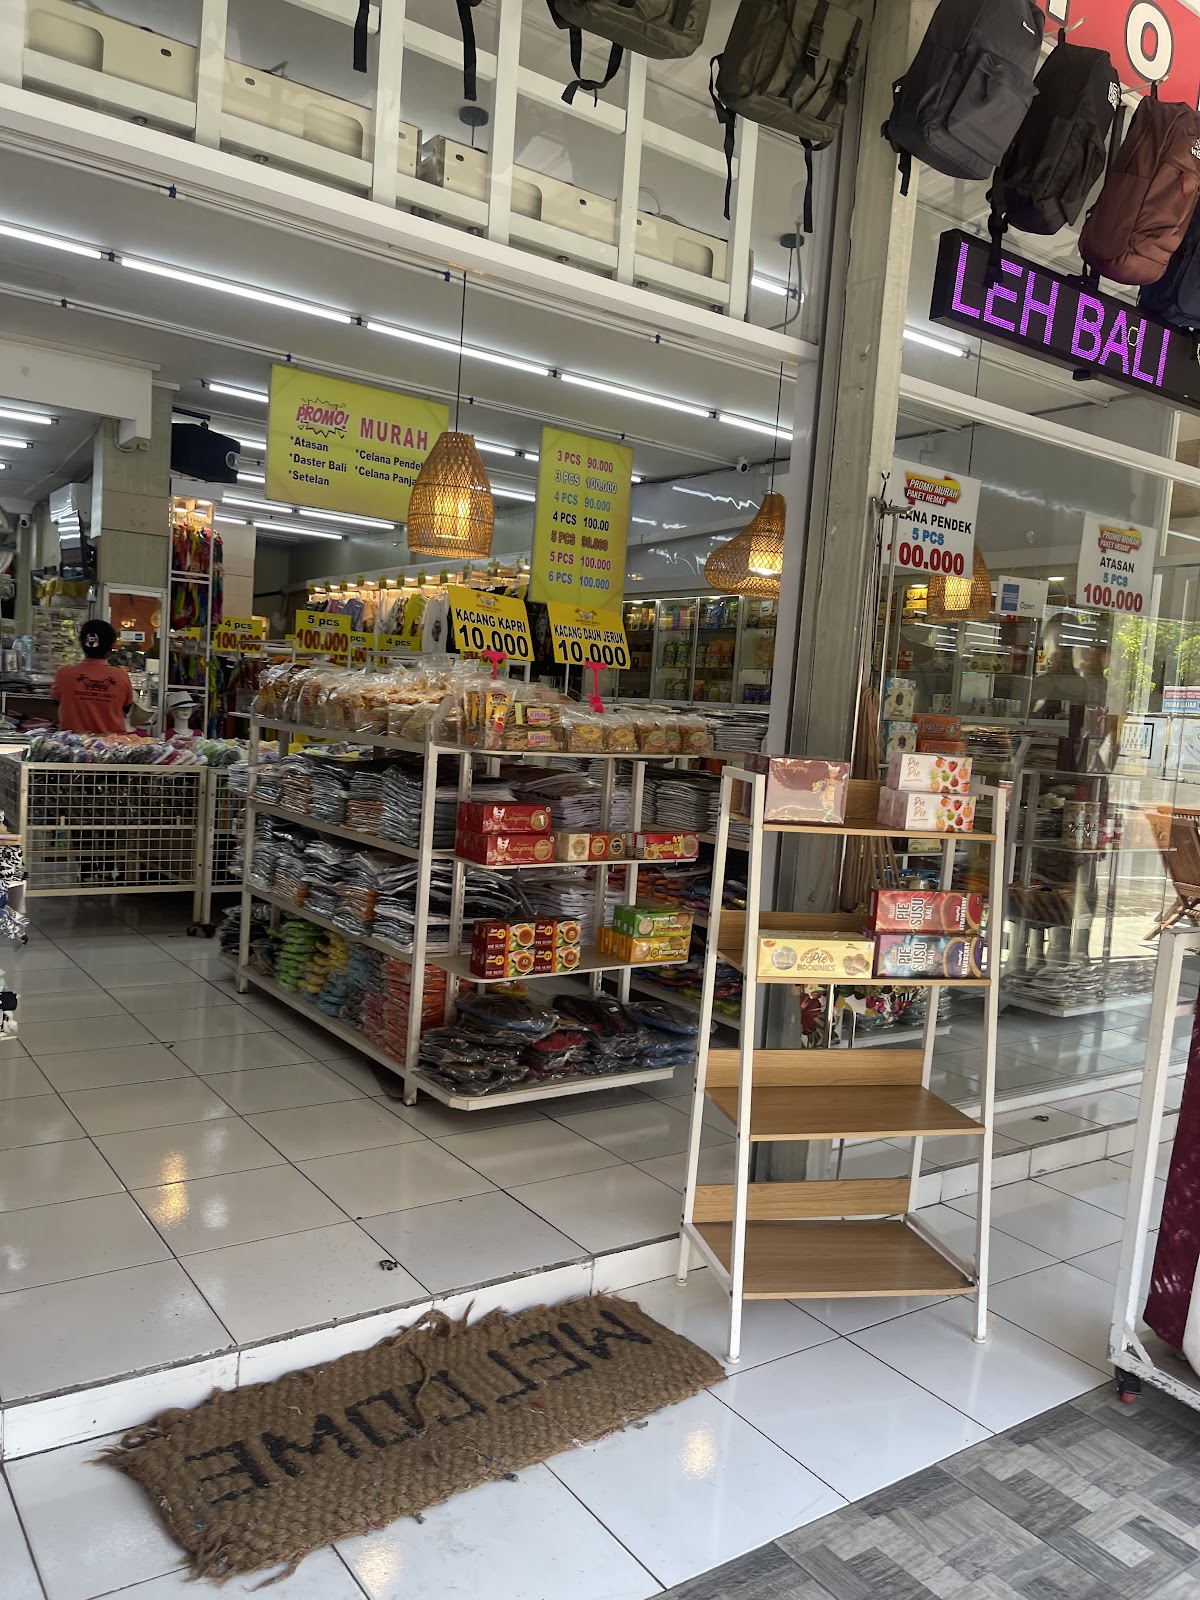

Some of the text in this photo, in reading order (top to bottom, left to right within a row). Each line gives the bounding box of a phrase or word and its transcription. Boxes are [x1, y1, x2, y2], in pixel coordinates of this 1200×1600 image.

[1070, 293, 1171, 388] BALI
[295, 405, 429, 451] PROMO! MURAH
[328, 460, 347, 472] Bali
[558, 450, 613, 473] 3 PCS 90.000
[555, 470, 617, 494] 3 PCS 100.000
[909, 479, 959, 499] PROMO MURAH
[554, 491, 611, 512] 4 PCS 90.000
[907, 489, 946, 505] PAKET HEMAT
[552, 511, 609, 531] 4 PCS 100.00
[931, 514, 972, 534] PENDEK
[551, 530, 557, 543] 5
[558, 531, 576, 545] PCS
[912, 527, 945, 545] 5 PCS
[549, 551, 611, 571] 5 PCS 100.000
[1099, 556, 1135, 573] ATASAN
[548, 571, 610, 590] 6 PCS 100.000
[1103, 572, 1128, 587] 5 PCS
[1020, 601, 1035, 610] Open
[1084, 583, 1143, 612] 100.000
[224, 619, 253, 630] 4 pcs
[307, 615, 340, 627] 5 pcs
[455, 608, 496, 627] KACANG
[498, 617, 526, 633] KAPRI
[296, 628, 348, 652] 100.000
[459, 624, 528, 657] 10.000
[554, 624, 582, 639] KACANG
[603, 631, 624, 644] JERUK
[558, 640, 627, 667] 10.000
[908, 757, 919, 767] Pie
[907, 767, 920, 778] Pie
[913, 806, 927, 817] Pie
[914, 797, 925, 807] Pie
[895, 902, 910, 921] PIE
[909, 897, 925, 927] SUSU
[959, 897, 967, 931] STRAWBERRY
[806, 952, 828, 964] Pie
[898, 946, 912, 966] PIE
[911, 942, 927, 971] SUSU
[927, 950, 935, 965] BALI
[961, 941, 971, 975] BLUEBERRY
[797, 964, 836, 972] BROWNIES
